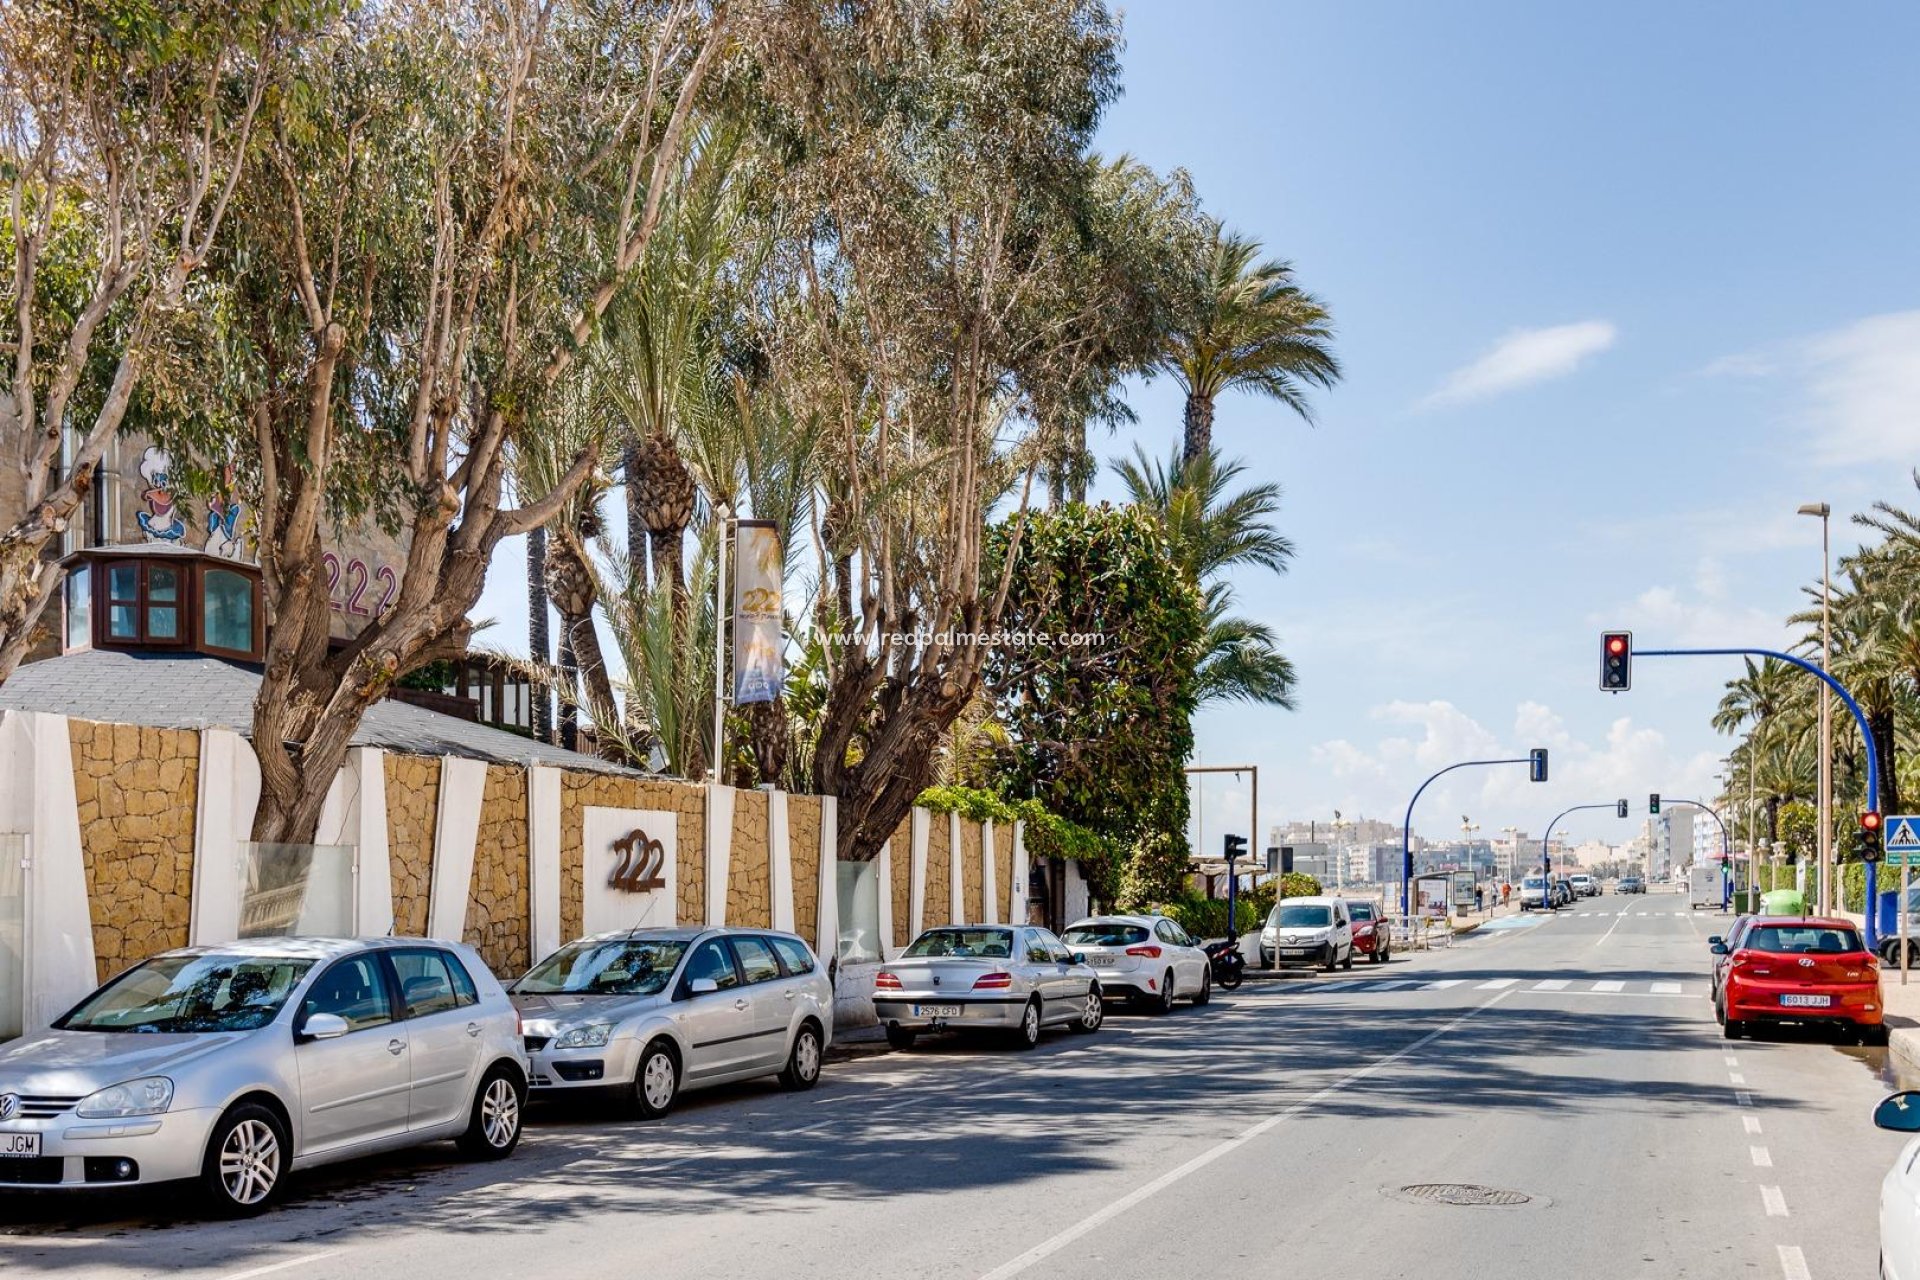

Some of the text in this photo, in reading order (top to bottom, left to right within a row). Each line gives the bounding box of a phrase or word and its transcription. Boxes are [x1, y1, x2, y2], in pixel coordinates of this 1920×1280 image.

[322, 551, 397, 617] 222
[613, 828, 666, 893] 222
[1786, 995, 1829, 1005] 6013 JJH
[6, 1135, 34, 1153] JGM
